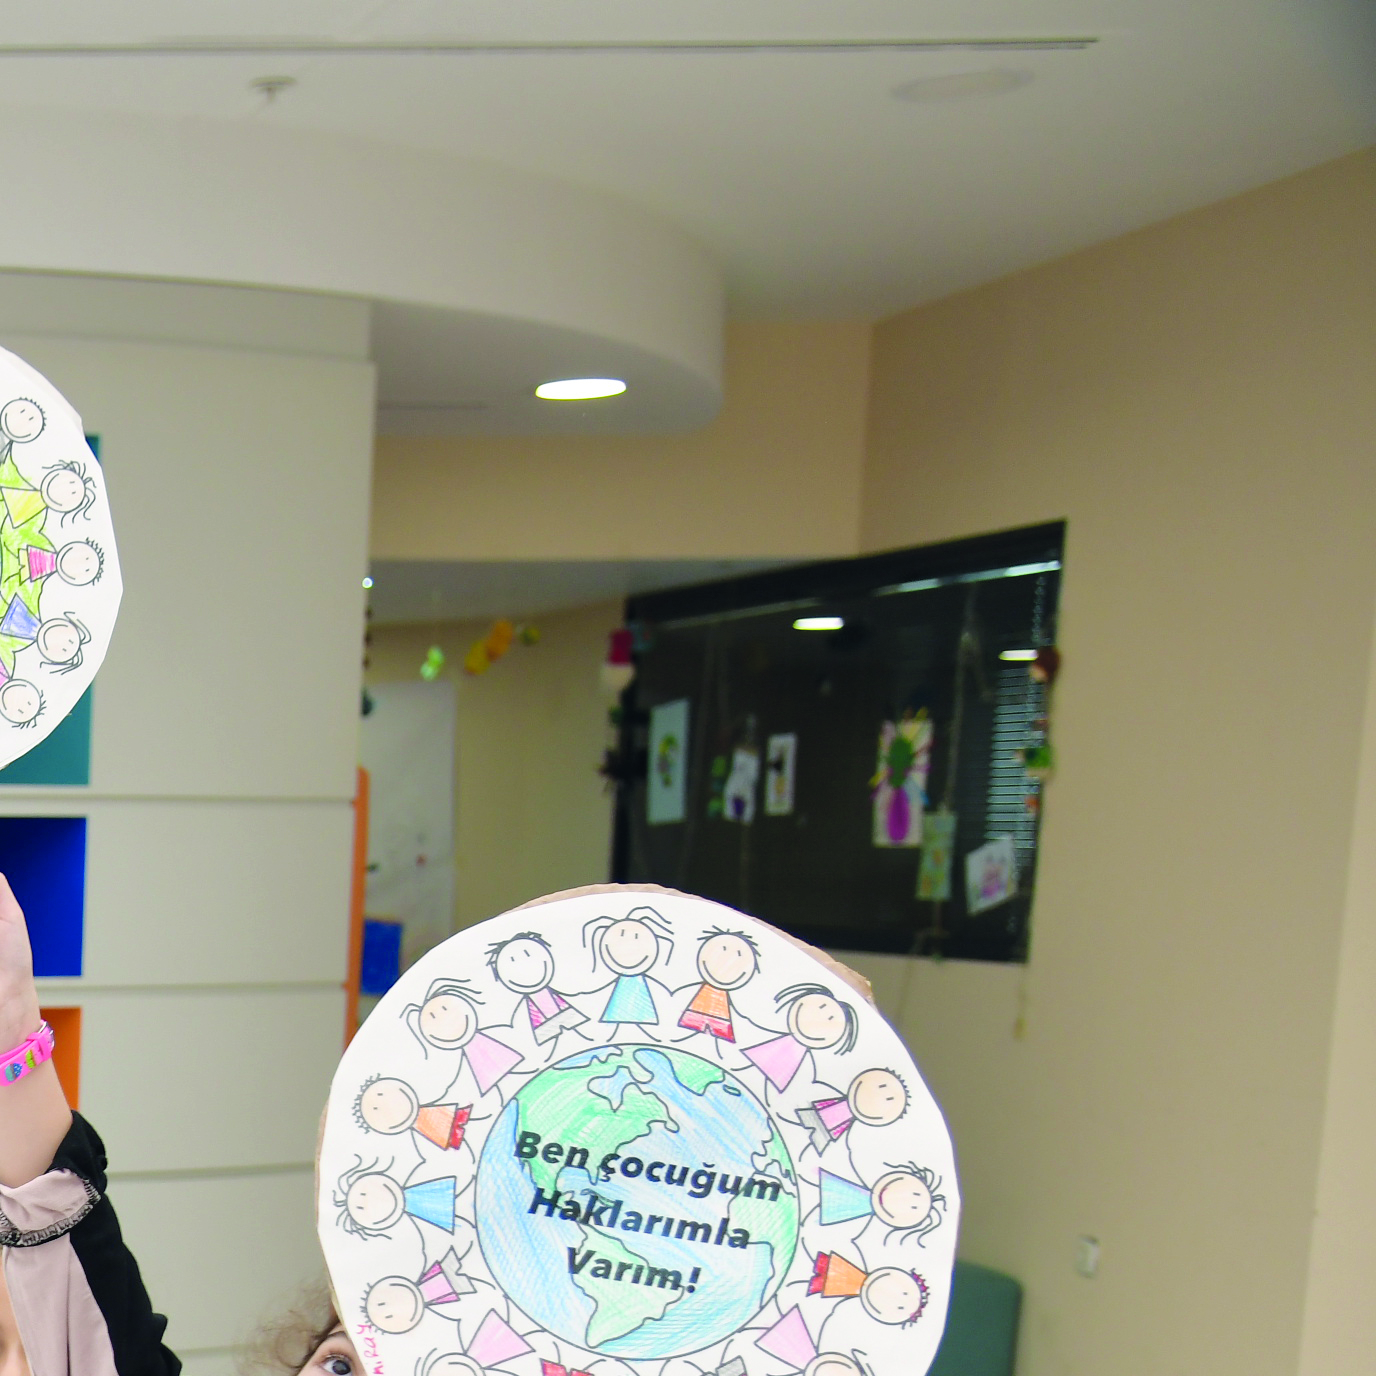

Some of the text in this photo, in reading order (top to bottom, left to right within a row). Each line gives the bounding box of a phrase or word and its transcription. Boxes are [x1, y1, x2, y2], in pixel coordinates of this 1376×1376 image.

[515, 1131, 782, 1203] Ben çocuğum
[527, 1189, 751, 1251] Haklarımla
[566, 1247, 703, 1294] Varım!
